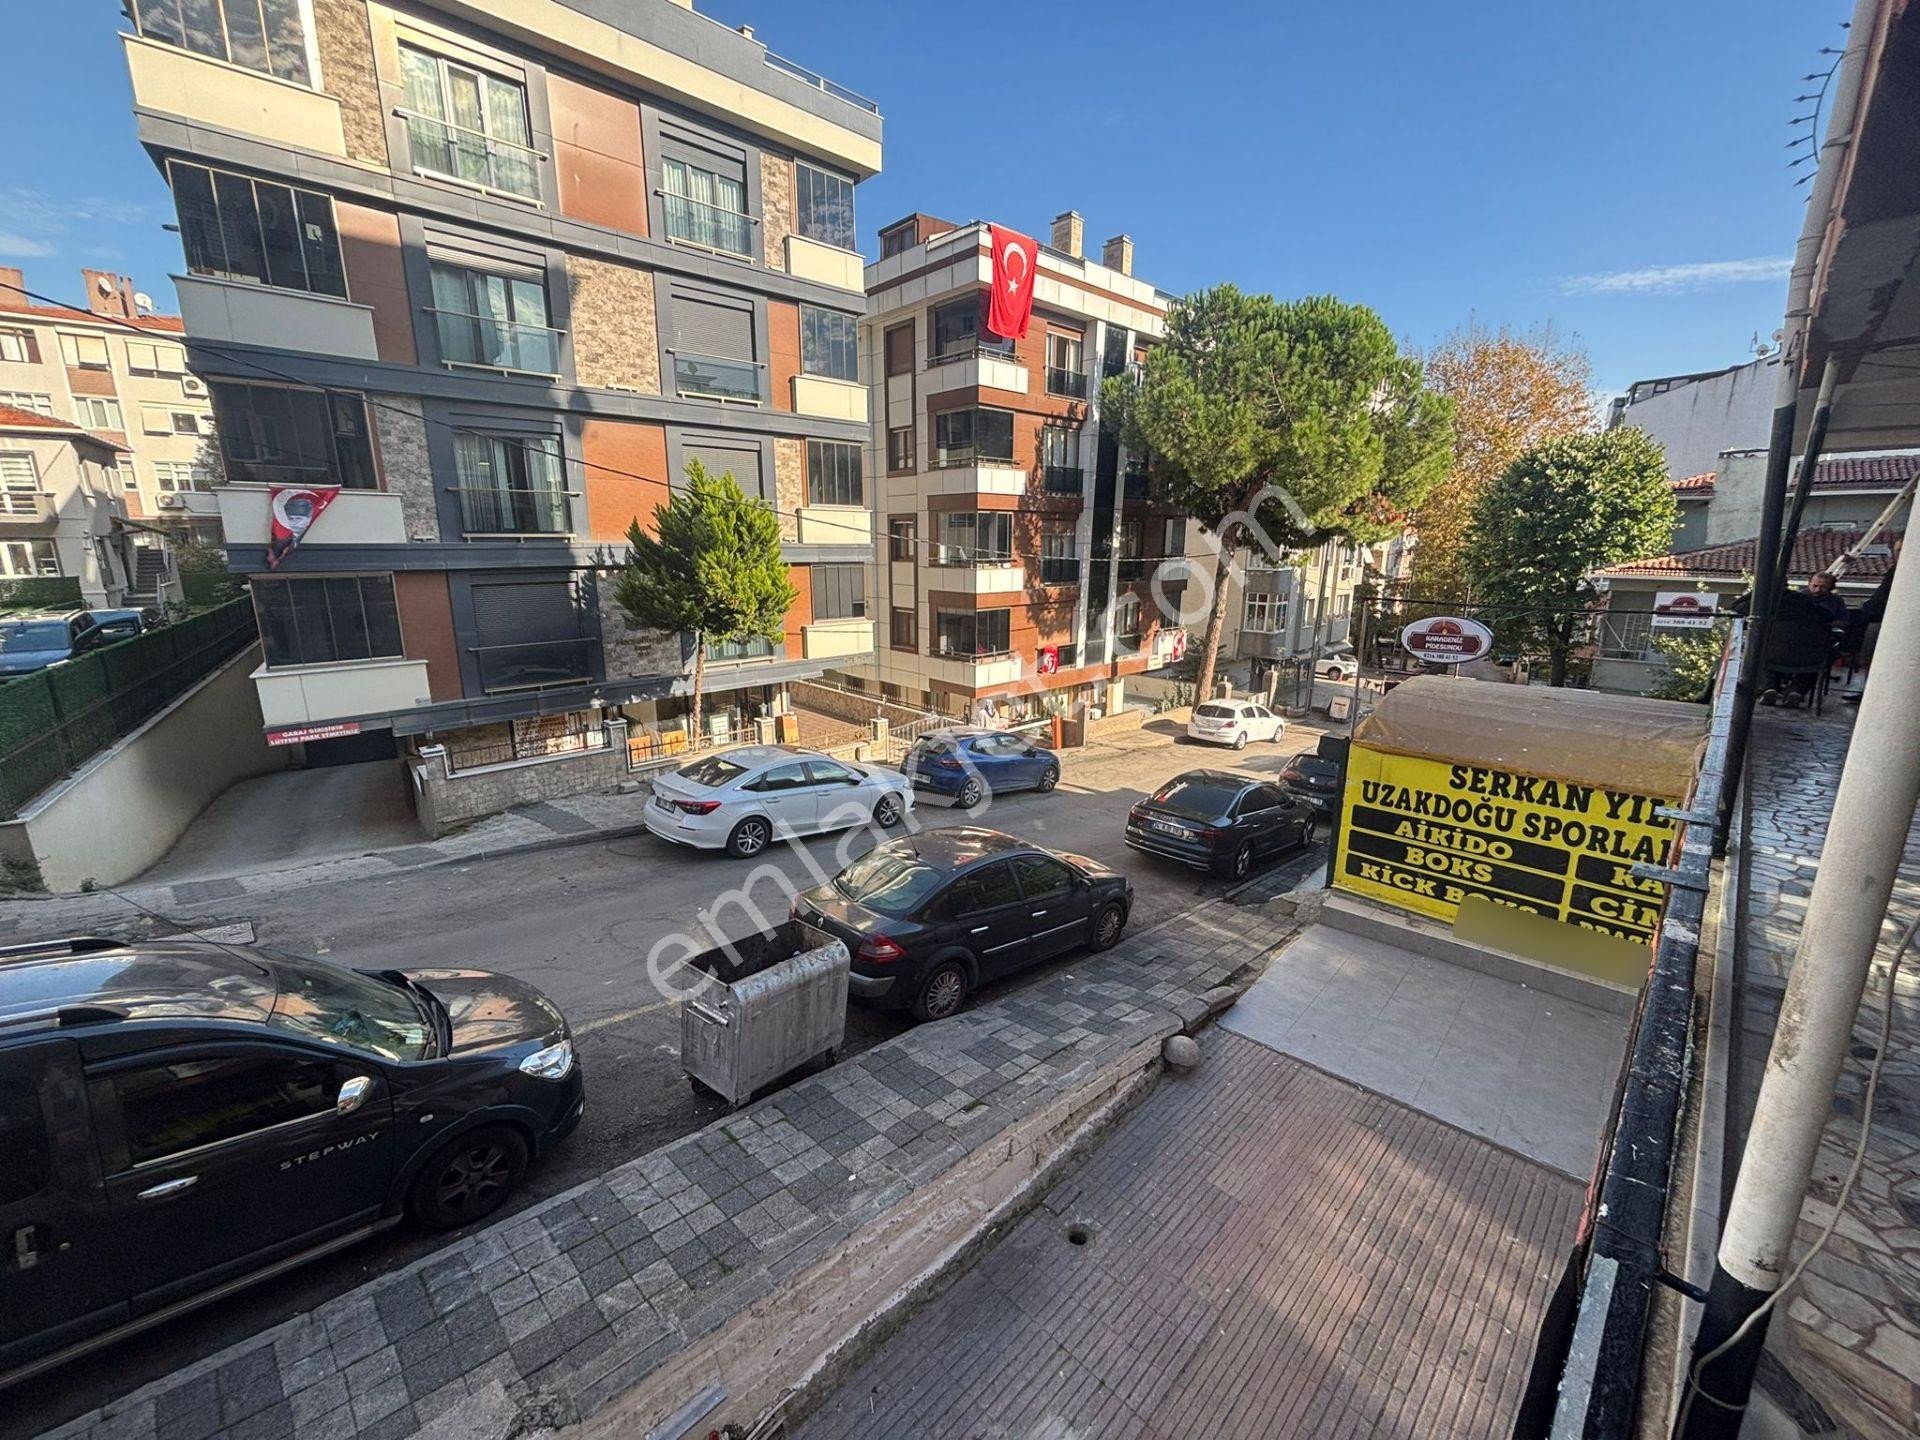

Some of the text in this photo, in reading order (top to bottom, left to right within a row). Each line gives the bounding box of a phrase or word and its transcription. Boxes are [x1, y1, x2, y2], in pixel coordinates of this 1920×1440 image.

[299, 734, 321, 742] PARK
[1361, 779, 1517, 833] UZAKDOĞU
[1449, 765, 1675, 829] SERKAN YIL
[1394, 819, 1513, 861] AİKİDO
[1359, 861, 1440, 898] KİCK
[1404, 846, 1493, 883] BOKS
[280, 1131, 380, 1171] STEPWAY
